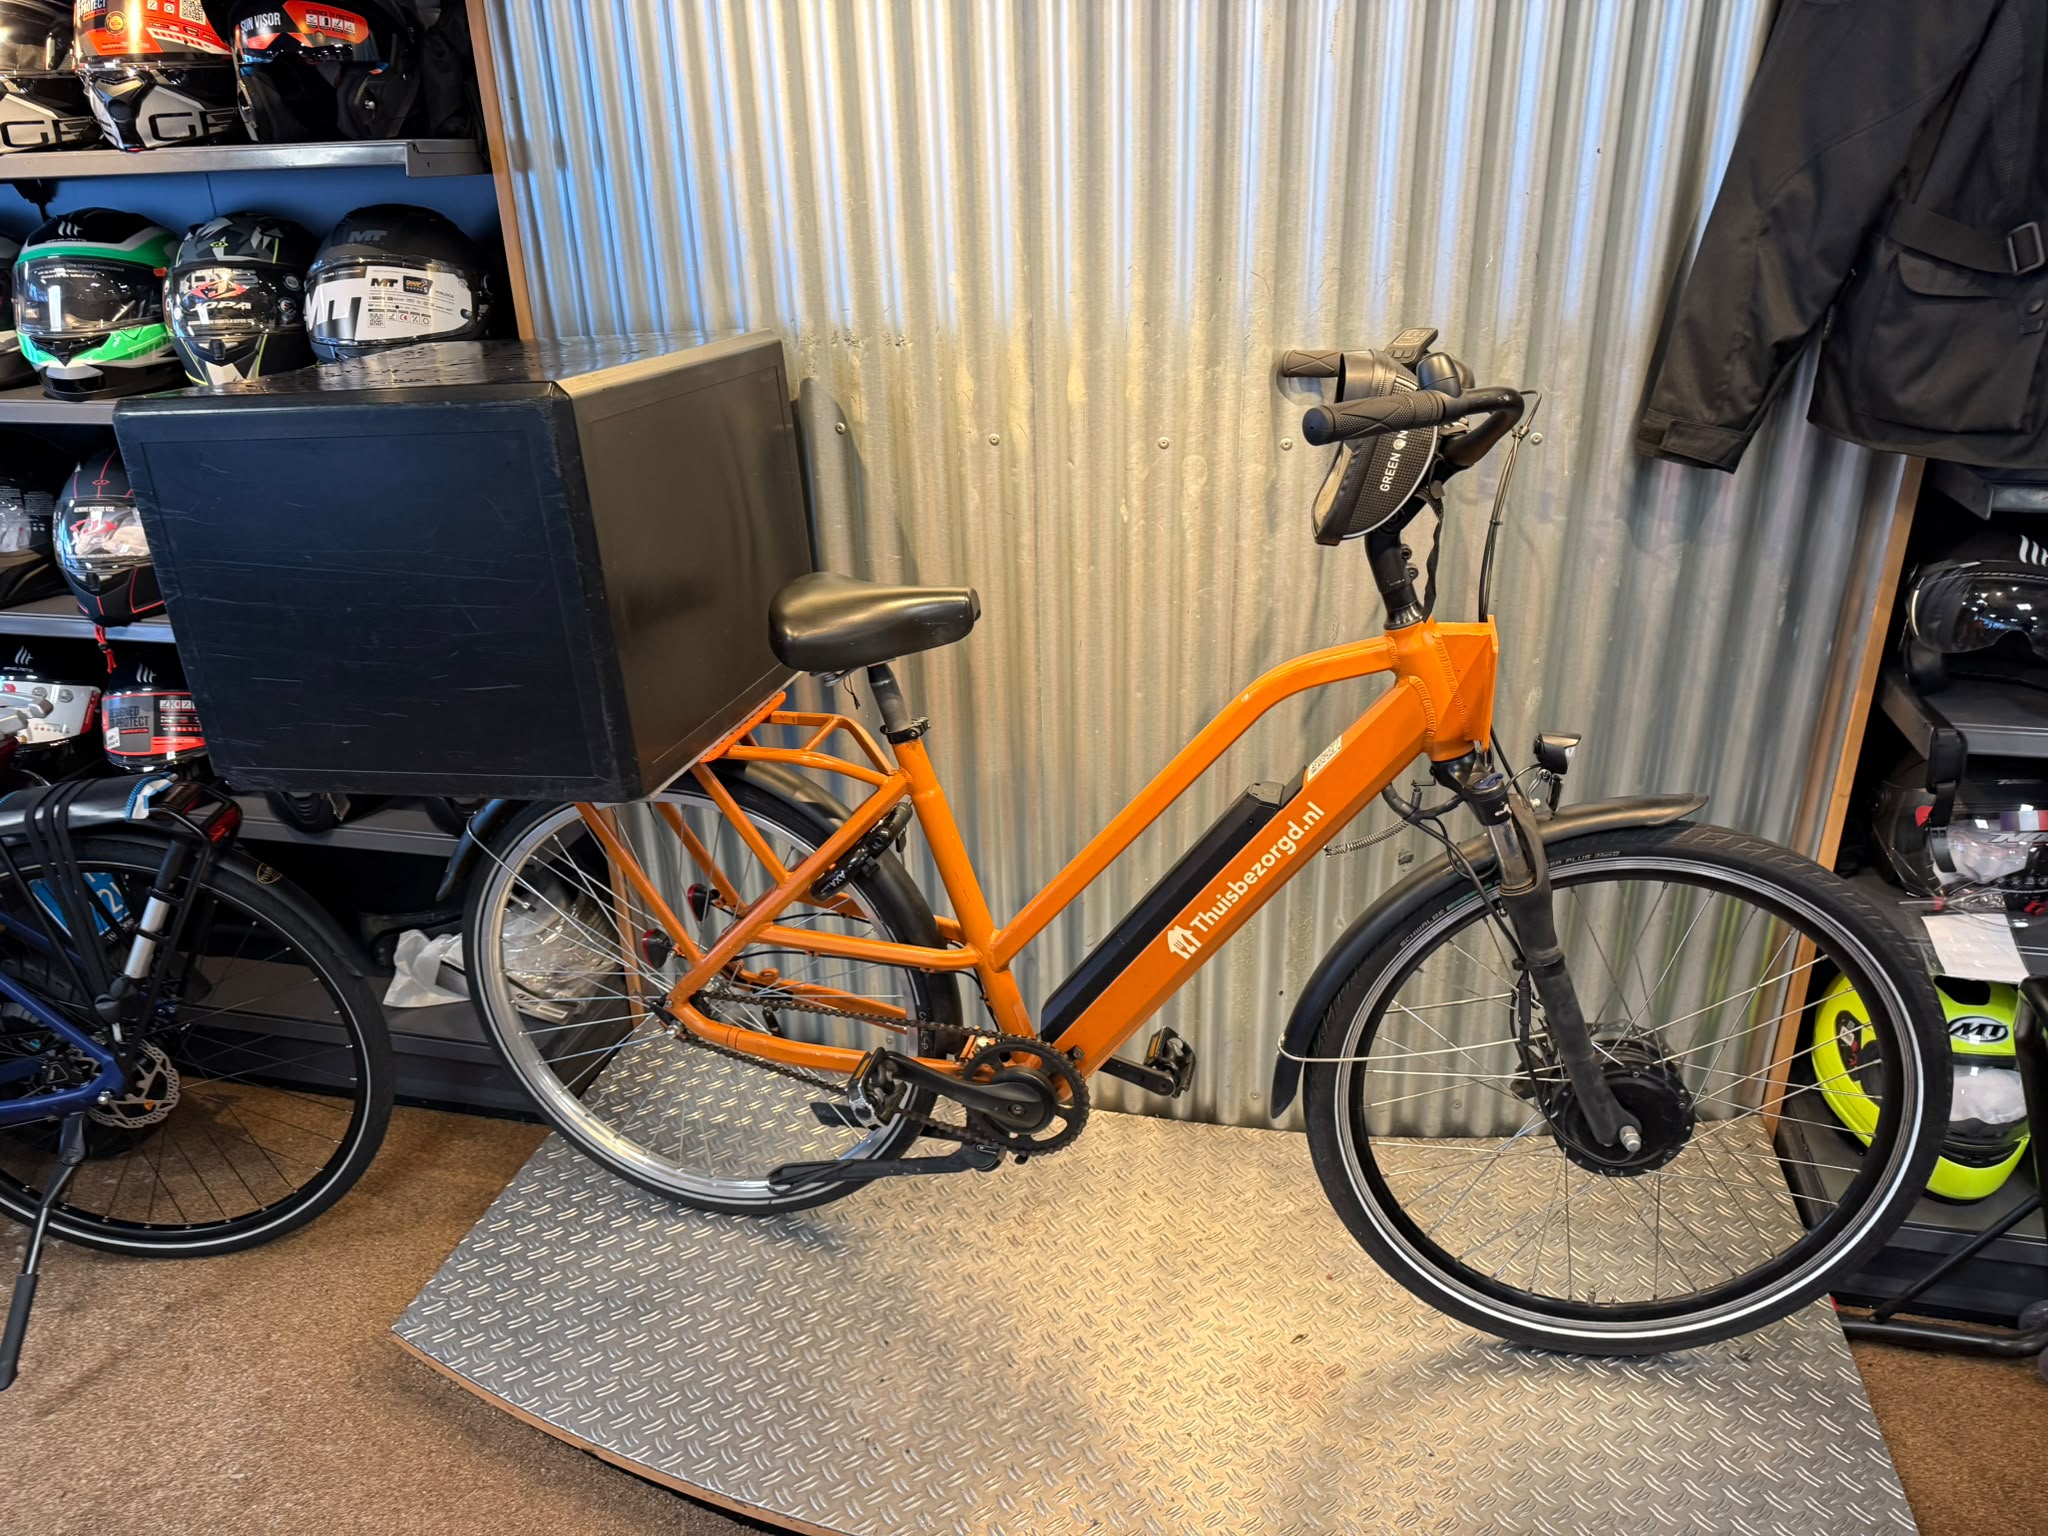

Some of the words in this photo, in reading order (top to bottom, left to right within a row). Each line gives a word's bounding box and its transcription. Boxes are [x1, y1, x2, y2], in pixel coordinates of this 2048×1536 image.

[240, 16, 254, 33] SUN
[254, 12, 281, 28] VISOR
[347, 230, 388, 243] MT
[371, 278, 398, 288] MT
[190, 301, 252, 312] JOPA
[1380, 453, 1401, 492] GREEN
[1190, 801, 1325, 933] Thuisbezorgd.nl
[1399, 908, 1446, 948] SCHWALBE
[1951, 1022, 2008, 1037] MT
